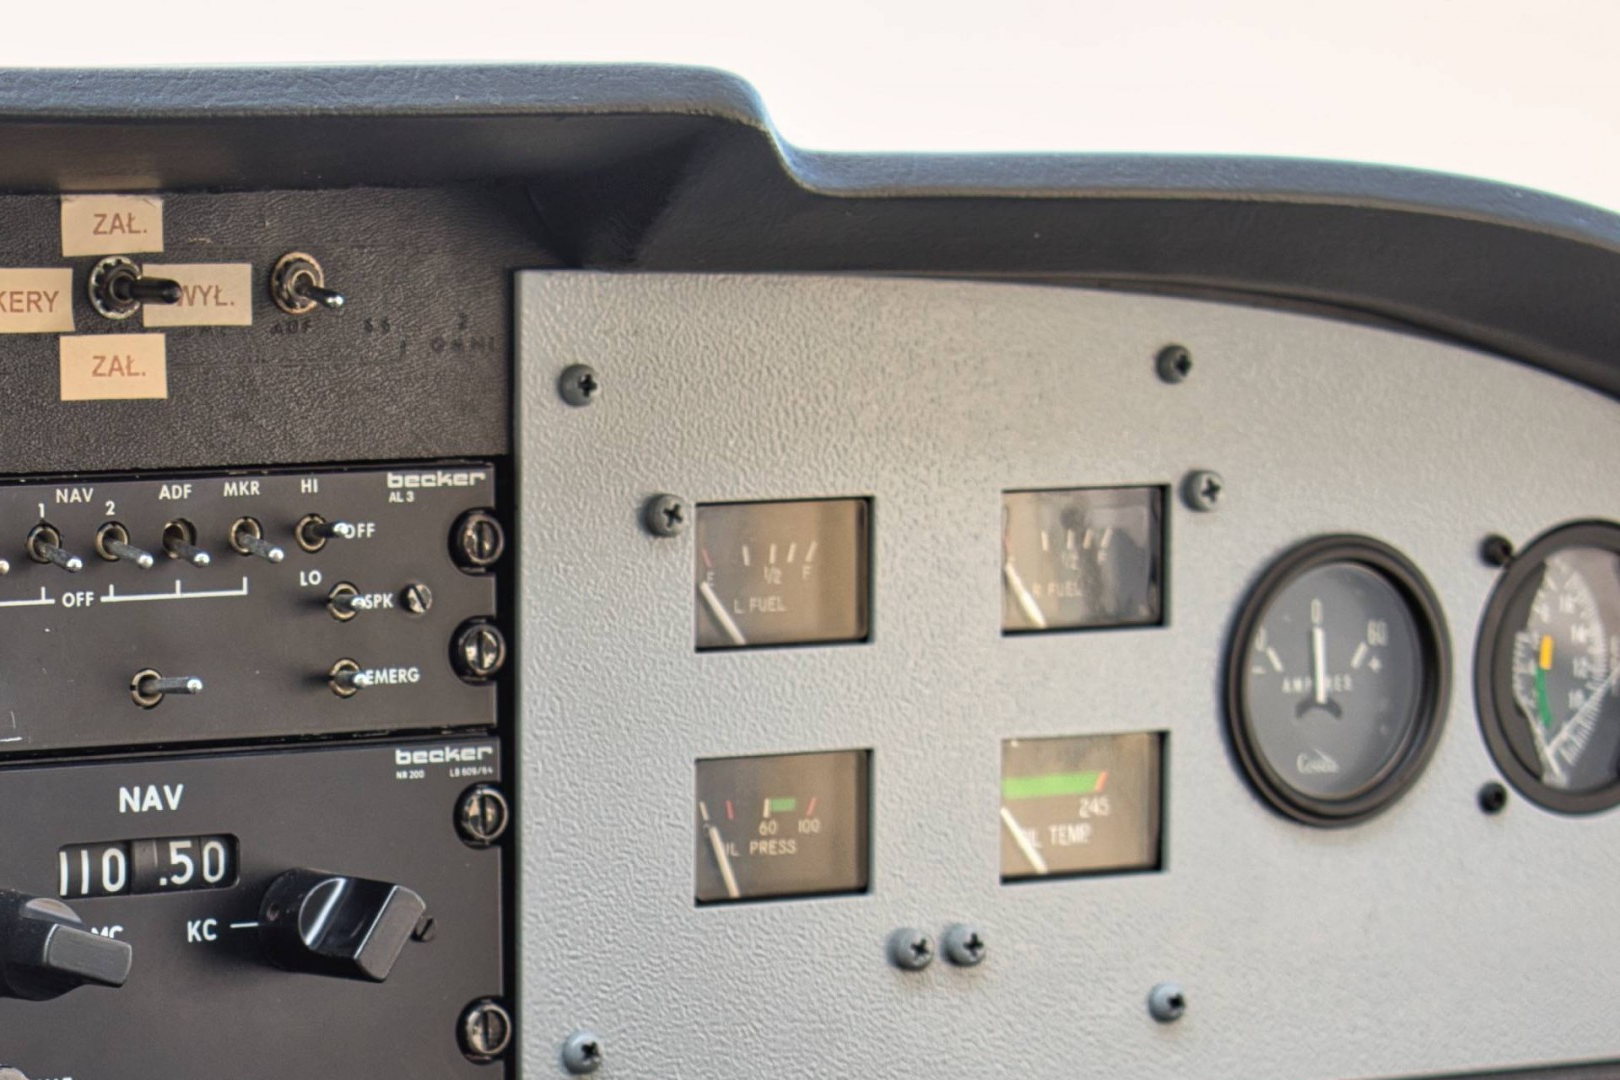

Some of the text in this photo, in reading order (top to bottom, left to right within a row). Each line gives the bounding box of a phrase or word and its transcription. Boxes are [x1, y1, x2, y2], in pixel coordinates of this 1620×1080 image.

[93, 213, 147, 235] ZAŁ.
[92, 355, 146, 378] ZAŁ.
[301, 479, 318, 493] HI
[387, 472, 485, 488] becker
[56, 488, 93, 503] NAV
[159, 485, 192, 500] ADF
[224, 482, 260, 497] MKR
[389, 491, 404, 502] AL
[38, 503, 45, 518] 1
[105, 501, 116, 515] 2
[343, 524, 375, 539] OFF
[300, 571, 322, 585] LO
[62, 592, 94, 607] OFF
[365, 593, 394, 609] SPK
[750, 596, 786, 612] FUEL
[365, 668, 420, 684] EMERG
[395, 746, 493, 765] becker
[119, 784, 184, 813] NAV
[1079, 798, 1109, 817] 245
[759, 819, 820, 835] 60 100
[1048, 824, 1090, 845] TEMP
[750, 840, 796, 855] PRESS
[187, 919, 217, 942] KC
